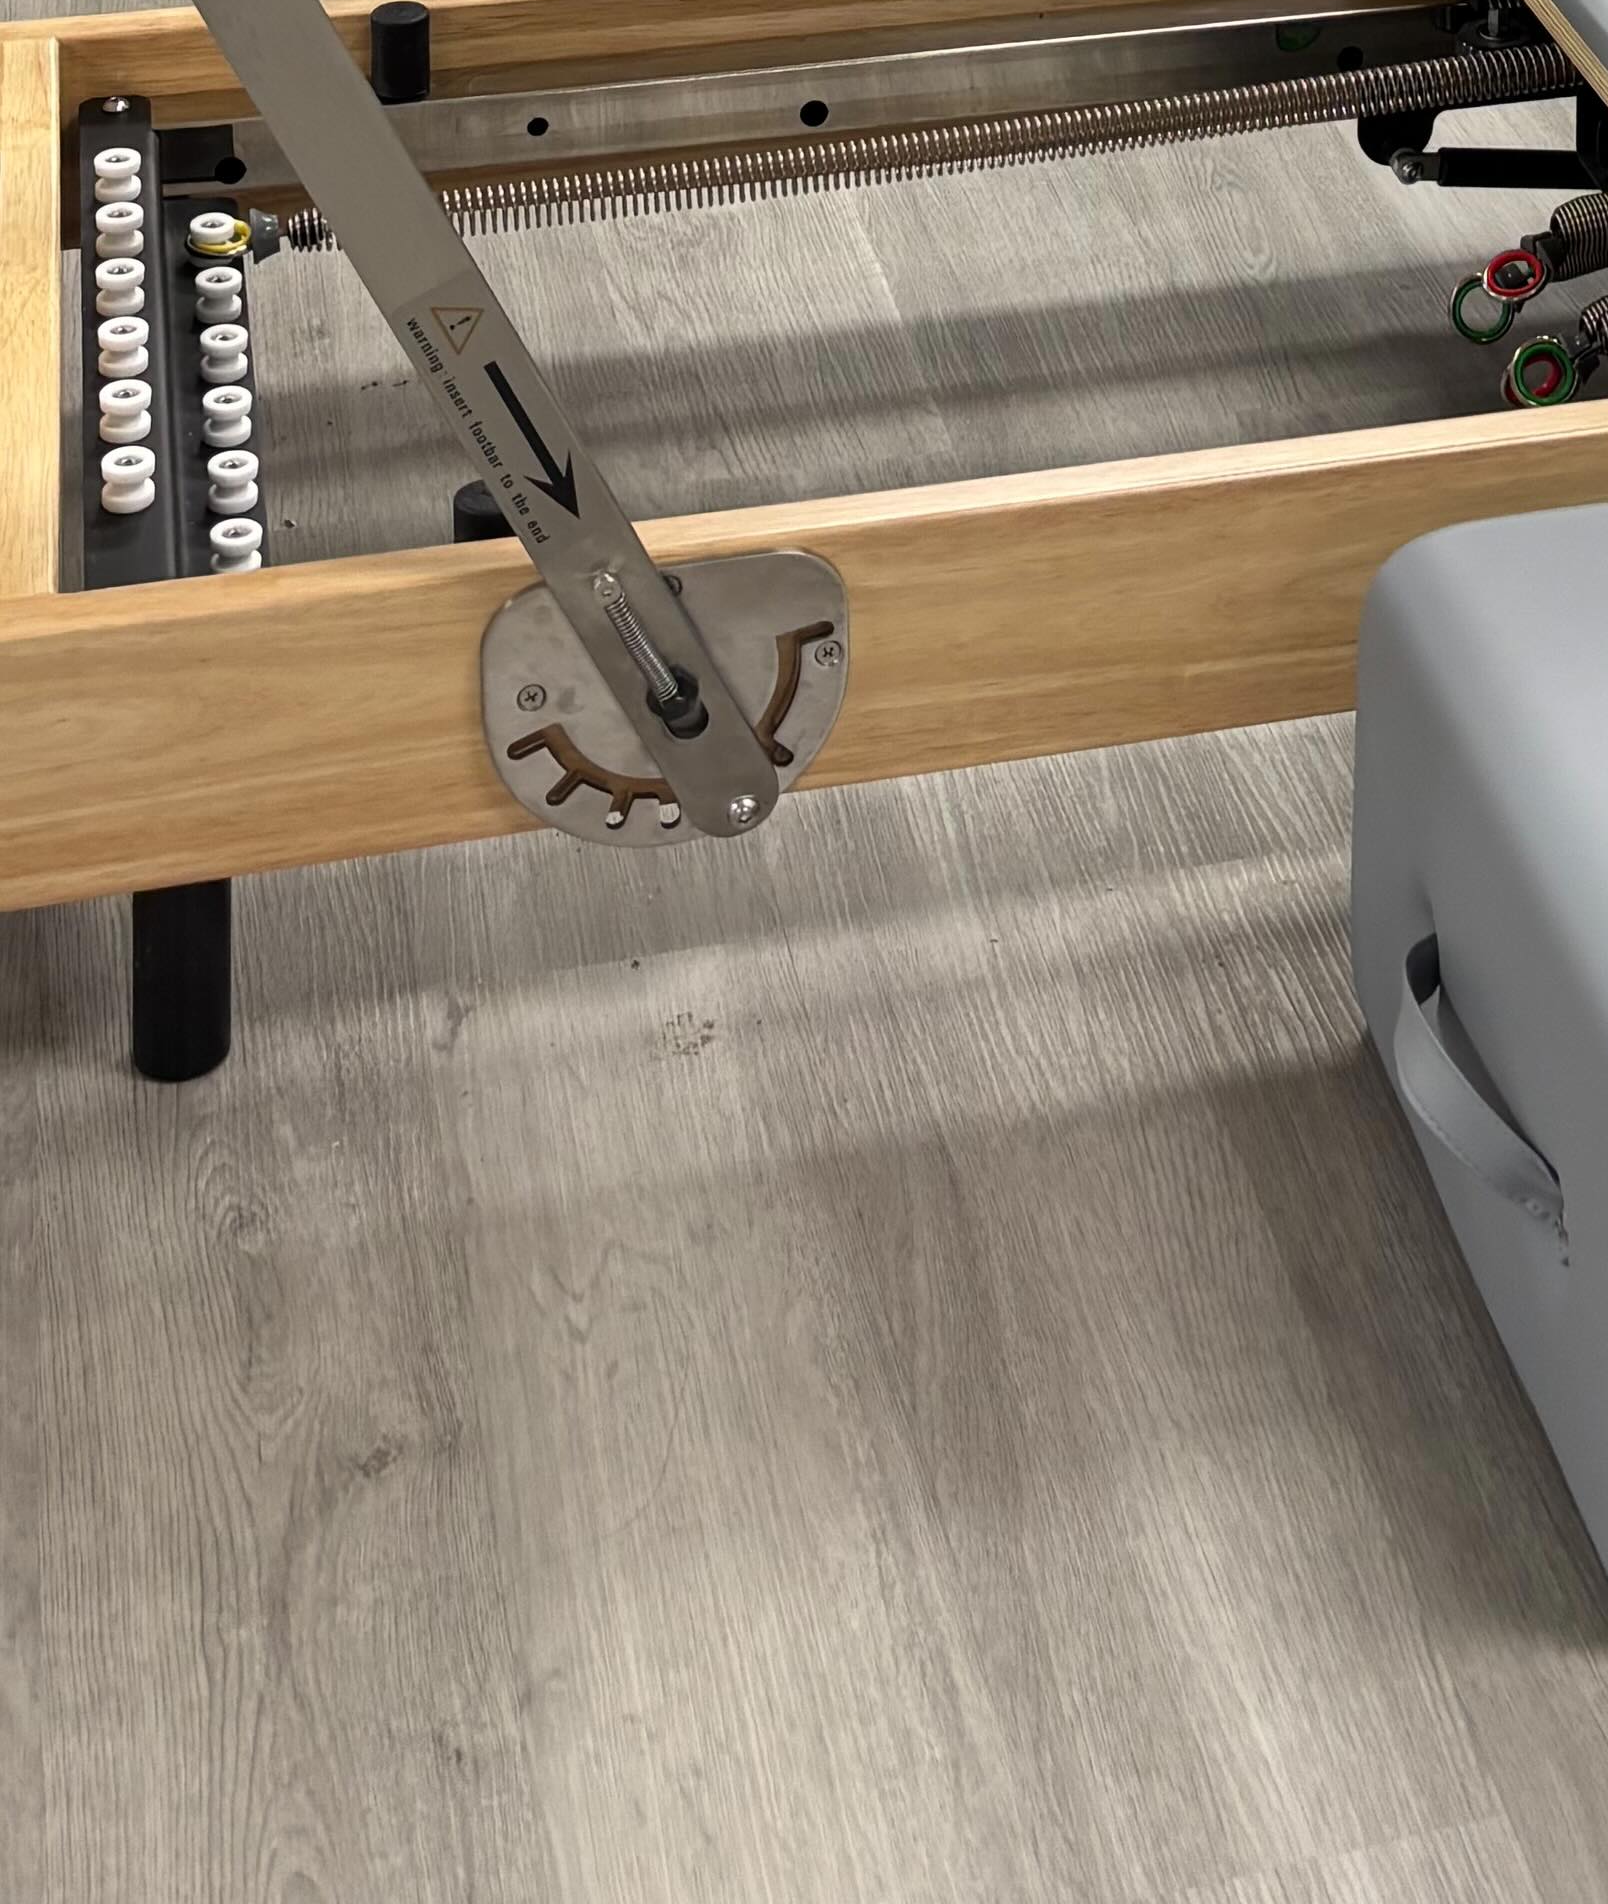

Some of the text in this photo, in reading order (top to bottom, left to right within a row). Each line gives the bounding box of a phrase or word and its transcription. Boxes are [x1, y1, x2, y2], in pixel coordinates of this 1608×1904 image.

[442, 375, 473, 419] insert
[468, 420, 504, 470] footbar
[500, 473, 514, 490] to
[511, 492, 530, 516] the
[527, 519, 551, 544] end
